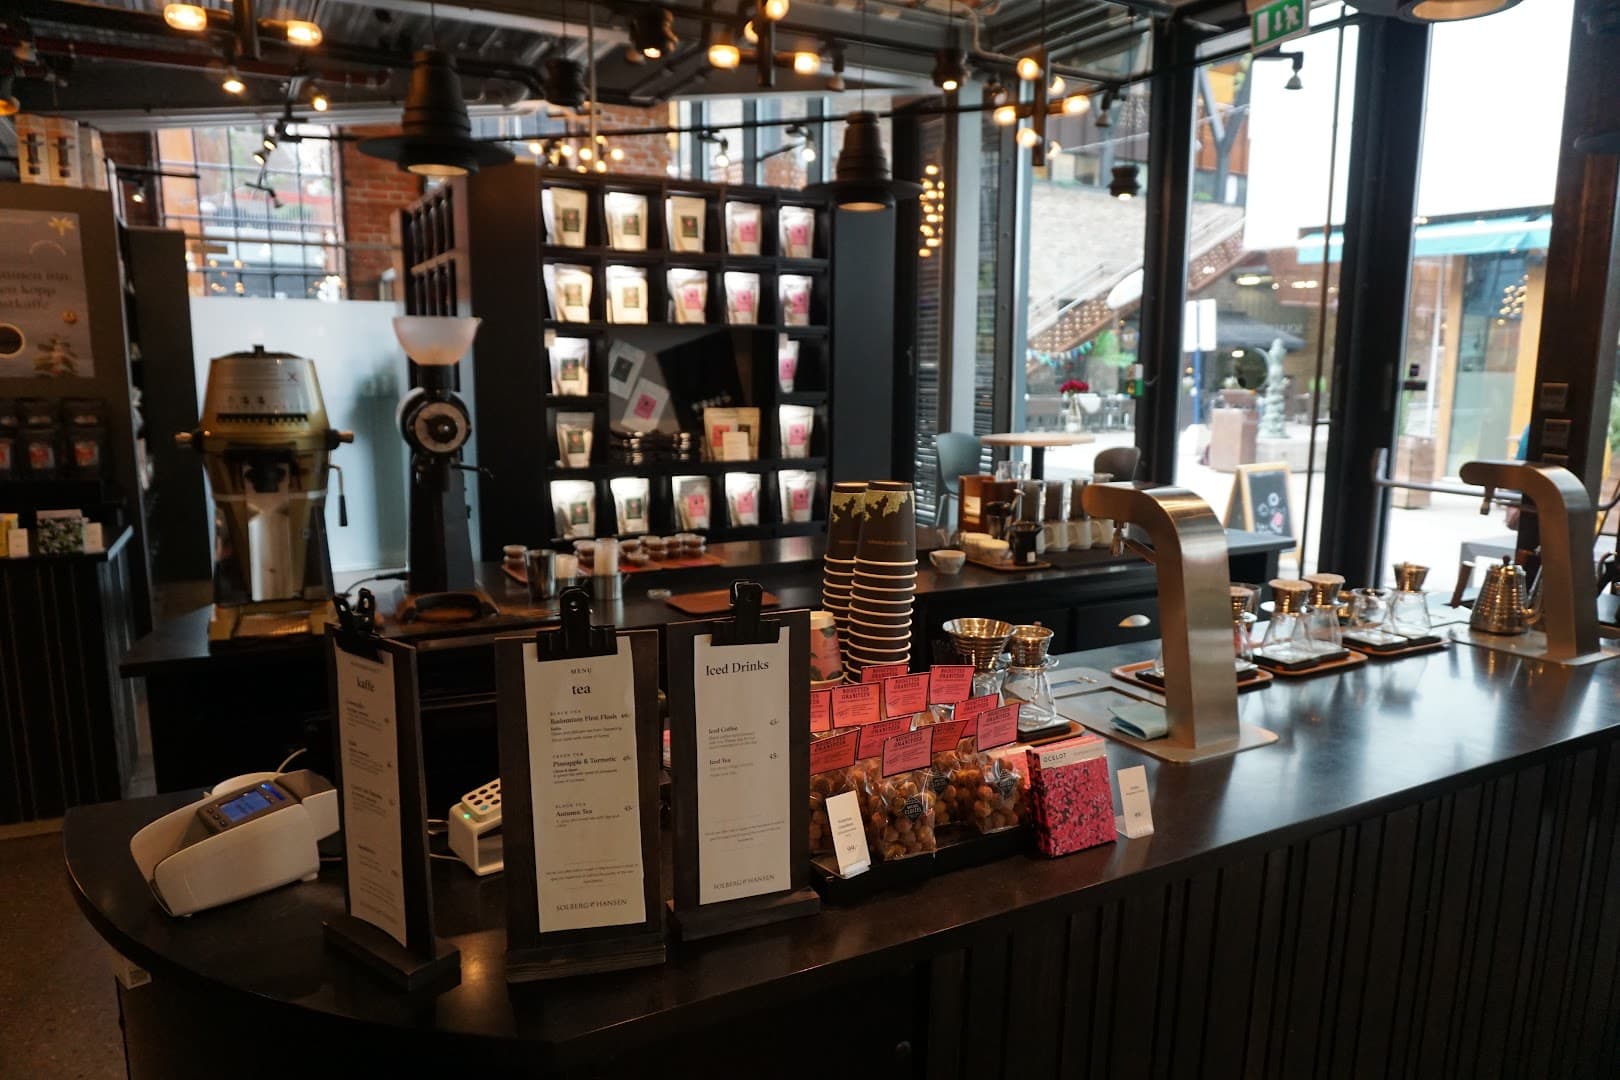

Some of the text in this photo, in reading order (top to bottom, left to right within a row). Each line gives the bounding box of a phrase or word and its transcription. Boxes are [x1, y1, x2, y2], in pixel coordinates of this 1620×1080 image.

[706, 659, 769, 677] Iced Drinks
[572, 684, 591, 695] tea
[552, 759, 582, 768] Pineapple
[590, 756, 617, 764] Turmeric
[556, 809, 580, 817] Autumn
